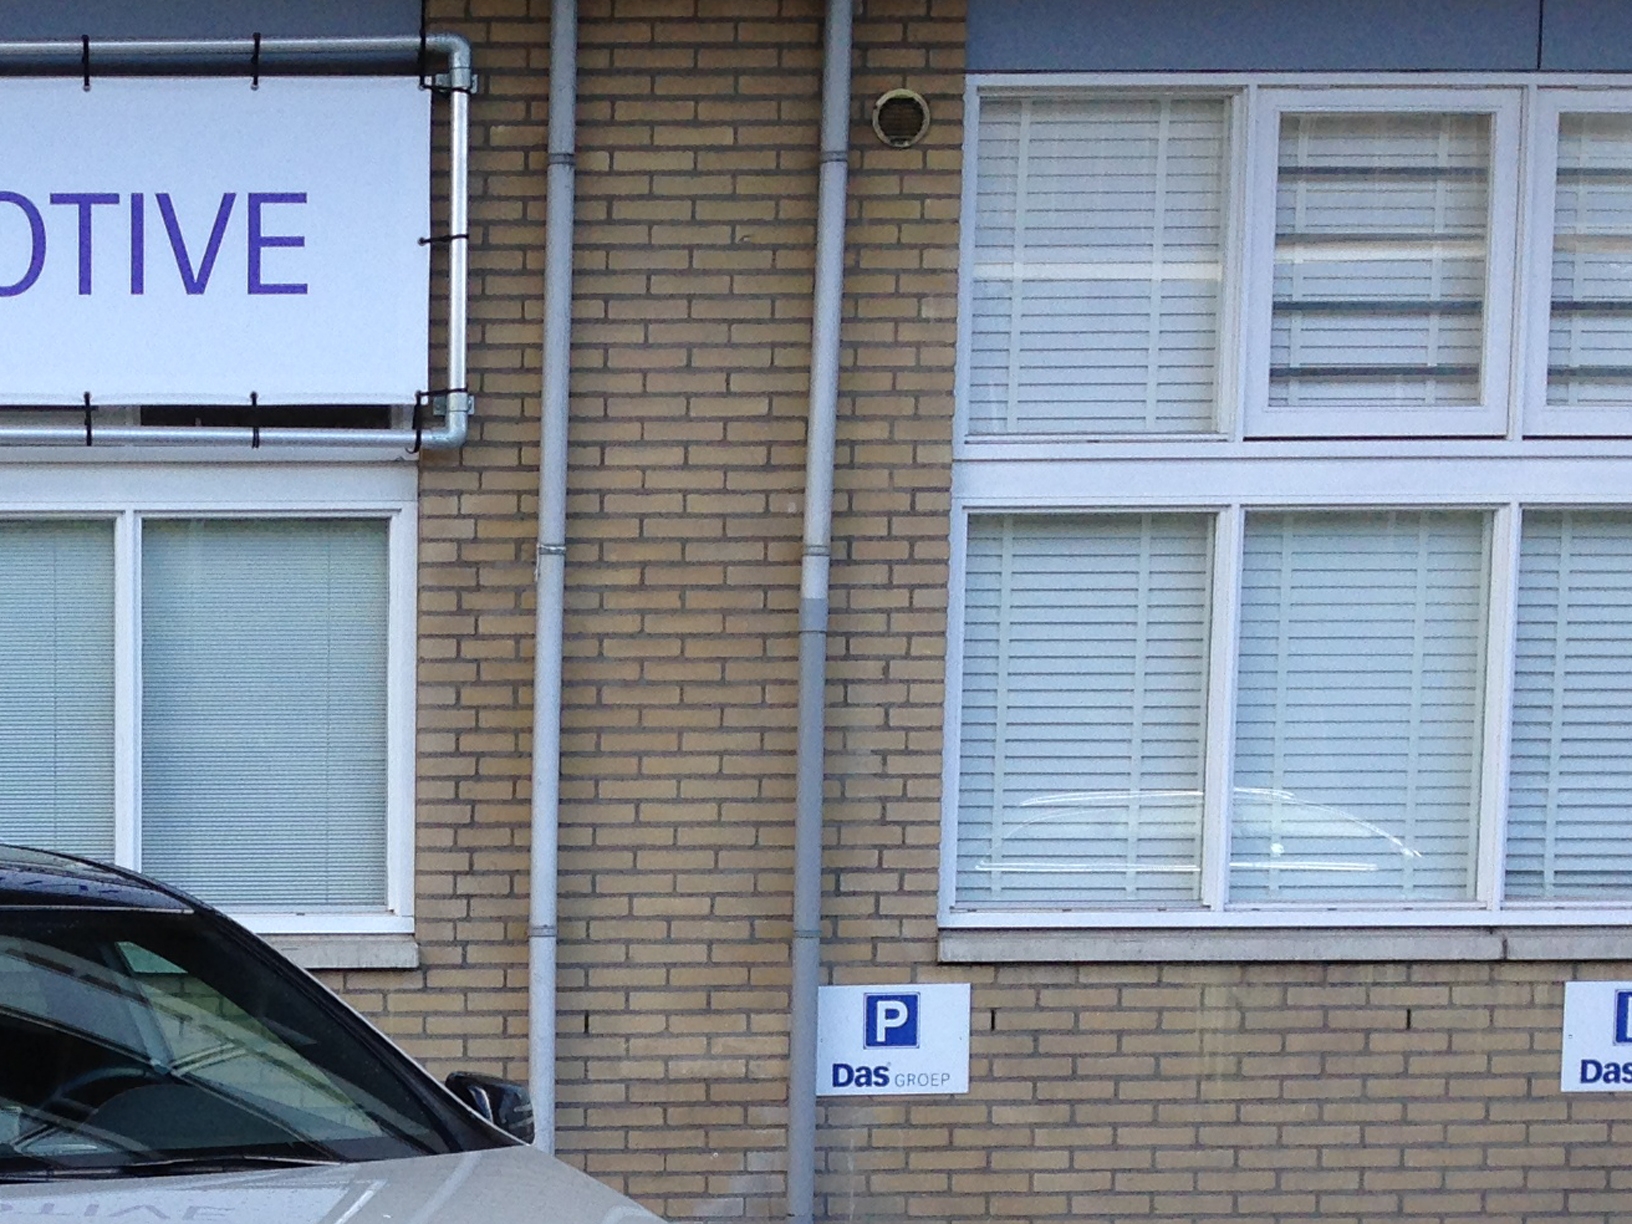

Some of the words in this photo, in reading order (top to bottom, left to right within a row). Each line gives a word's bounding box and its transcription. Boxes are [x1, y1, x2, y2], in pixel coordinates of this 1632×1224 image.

[876, 1000, 909, 1042] P
[831, 1062, 890, 1088] Das
[894, 1072, 951, 1088] GROEP
